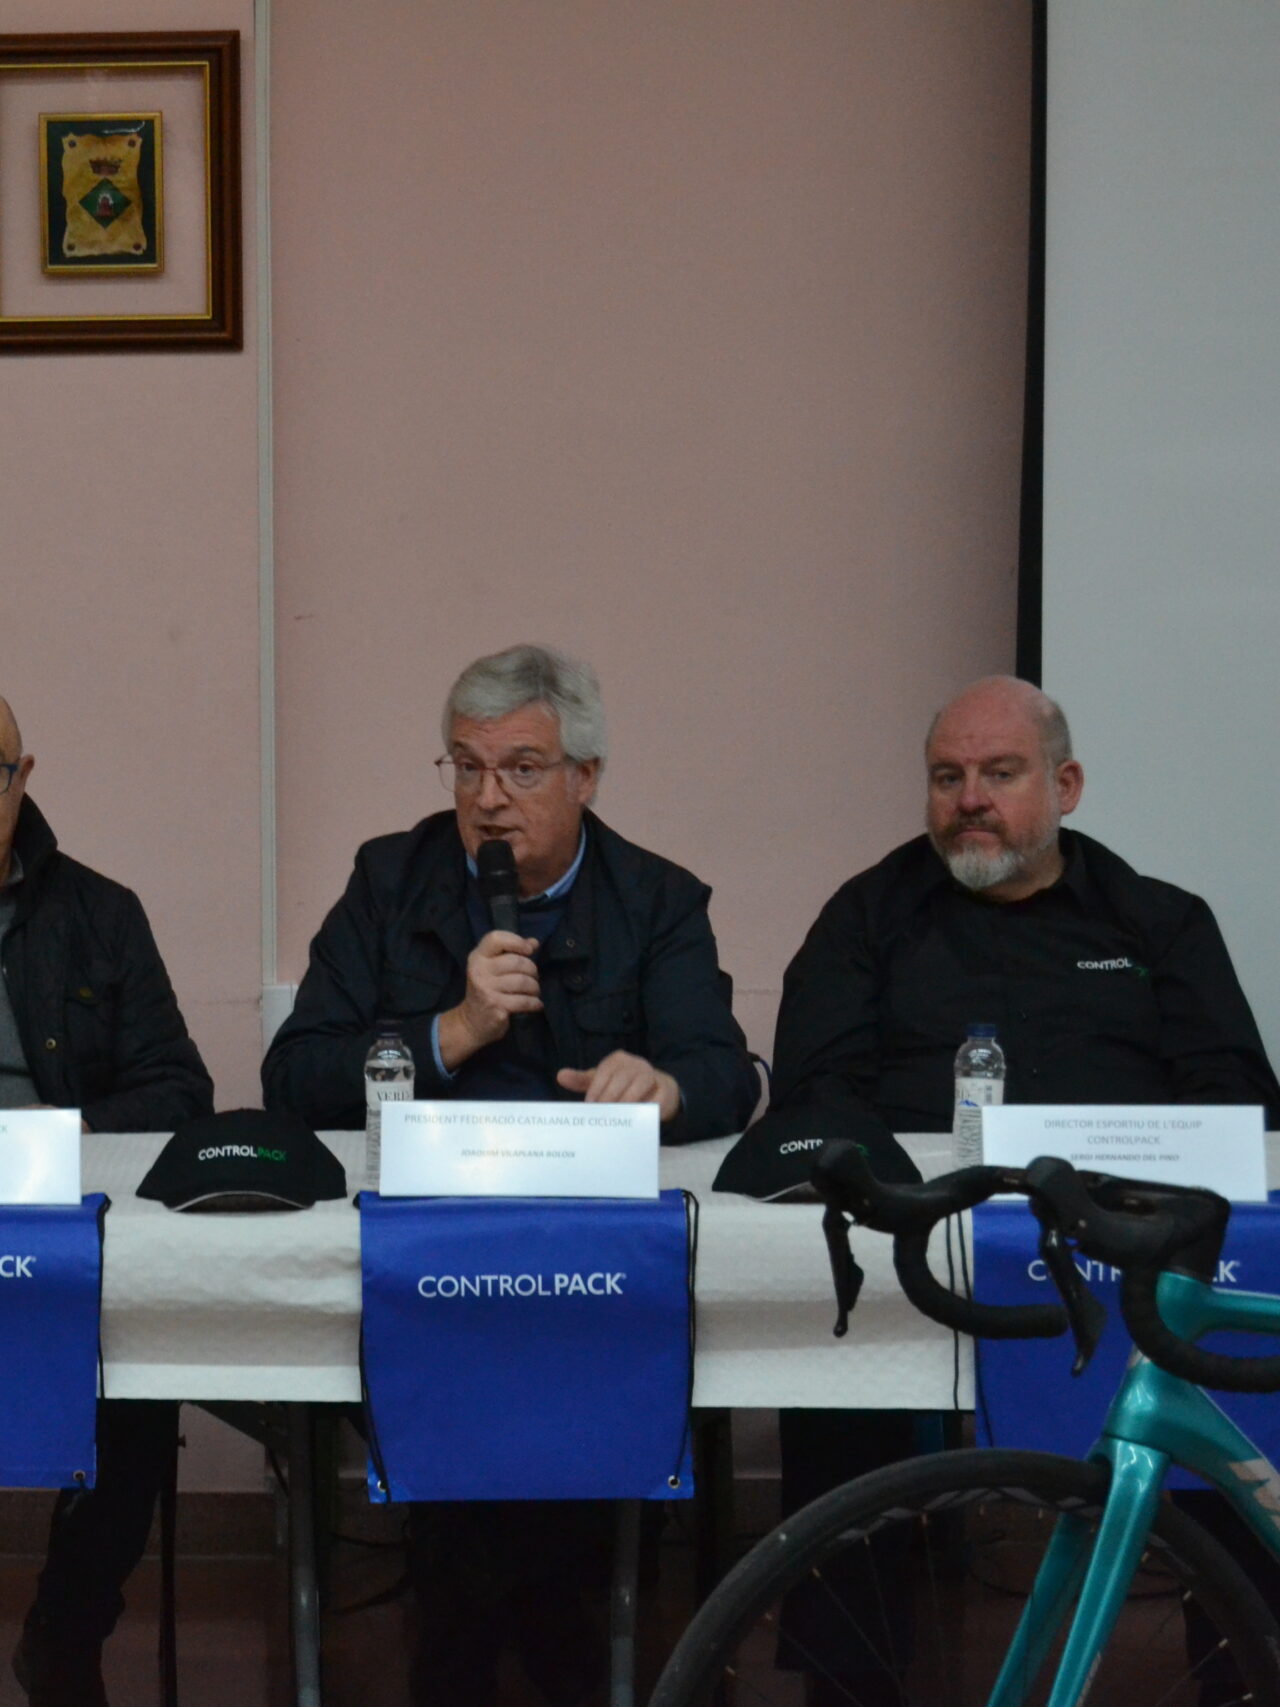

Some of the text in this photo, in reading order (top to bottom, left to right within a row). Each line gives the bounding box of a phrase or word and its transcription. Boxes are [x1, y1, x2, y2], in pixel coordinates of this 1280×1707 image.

[405, 1114, 633, 1128] PRESIDENT FEDERACIÓ CATALANA DE CICLISME
[1044, 1119, 1202, 1130] DIRECTOR ESPORTIU DE L'EQUIP
[1087, 1135, 1161, 1145] CONTROLPACK
[198, 1145, 286, 1161] CONTROLPACK
